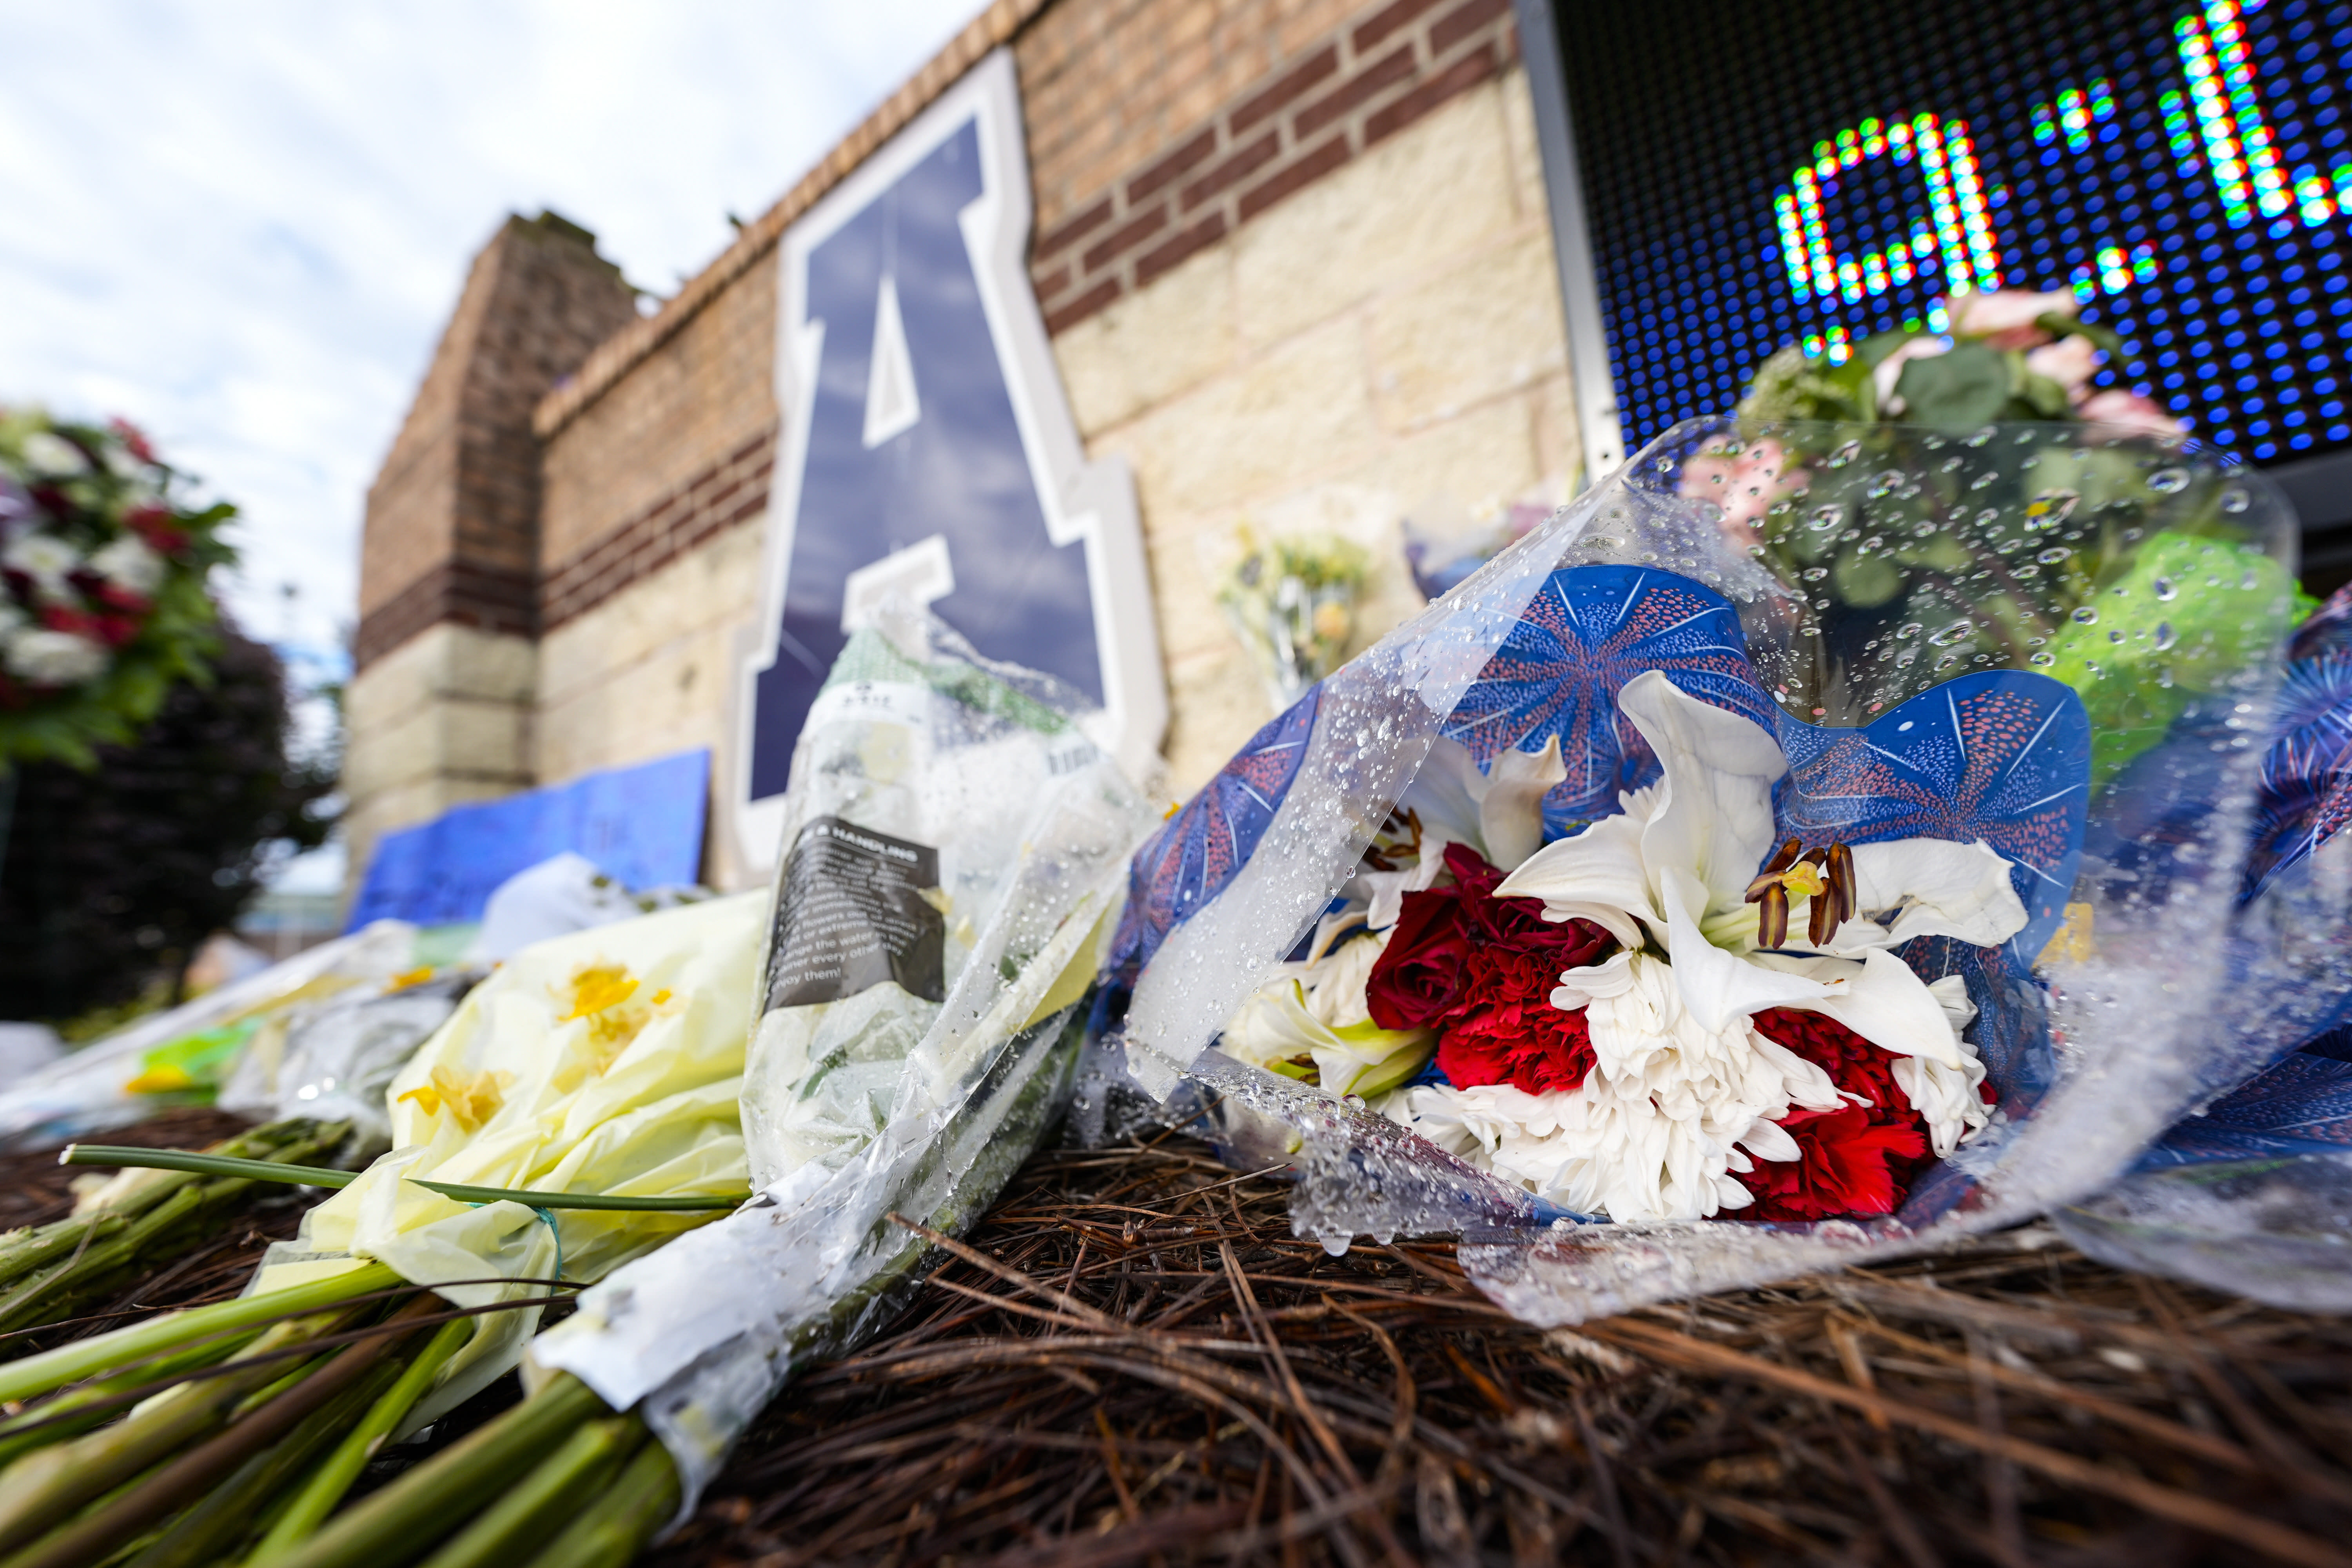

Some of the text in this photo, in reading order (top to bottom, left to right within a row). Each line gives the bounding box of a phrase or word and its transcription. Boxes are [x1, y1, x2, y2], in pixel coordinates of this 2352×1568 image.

[731, 46, 1172, 892] A
[816, 824, 829, 836] &
[832, 826, 918, 864] HANDLING
[811, 951, 848, 965] every
[849, 940, 880, 959] other
[815, 939, 837, 951] the
[839, 931, 873, 946] water
[888, 934, 907, 949] the
[804, 965, 841, 982] them!
